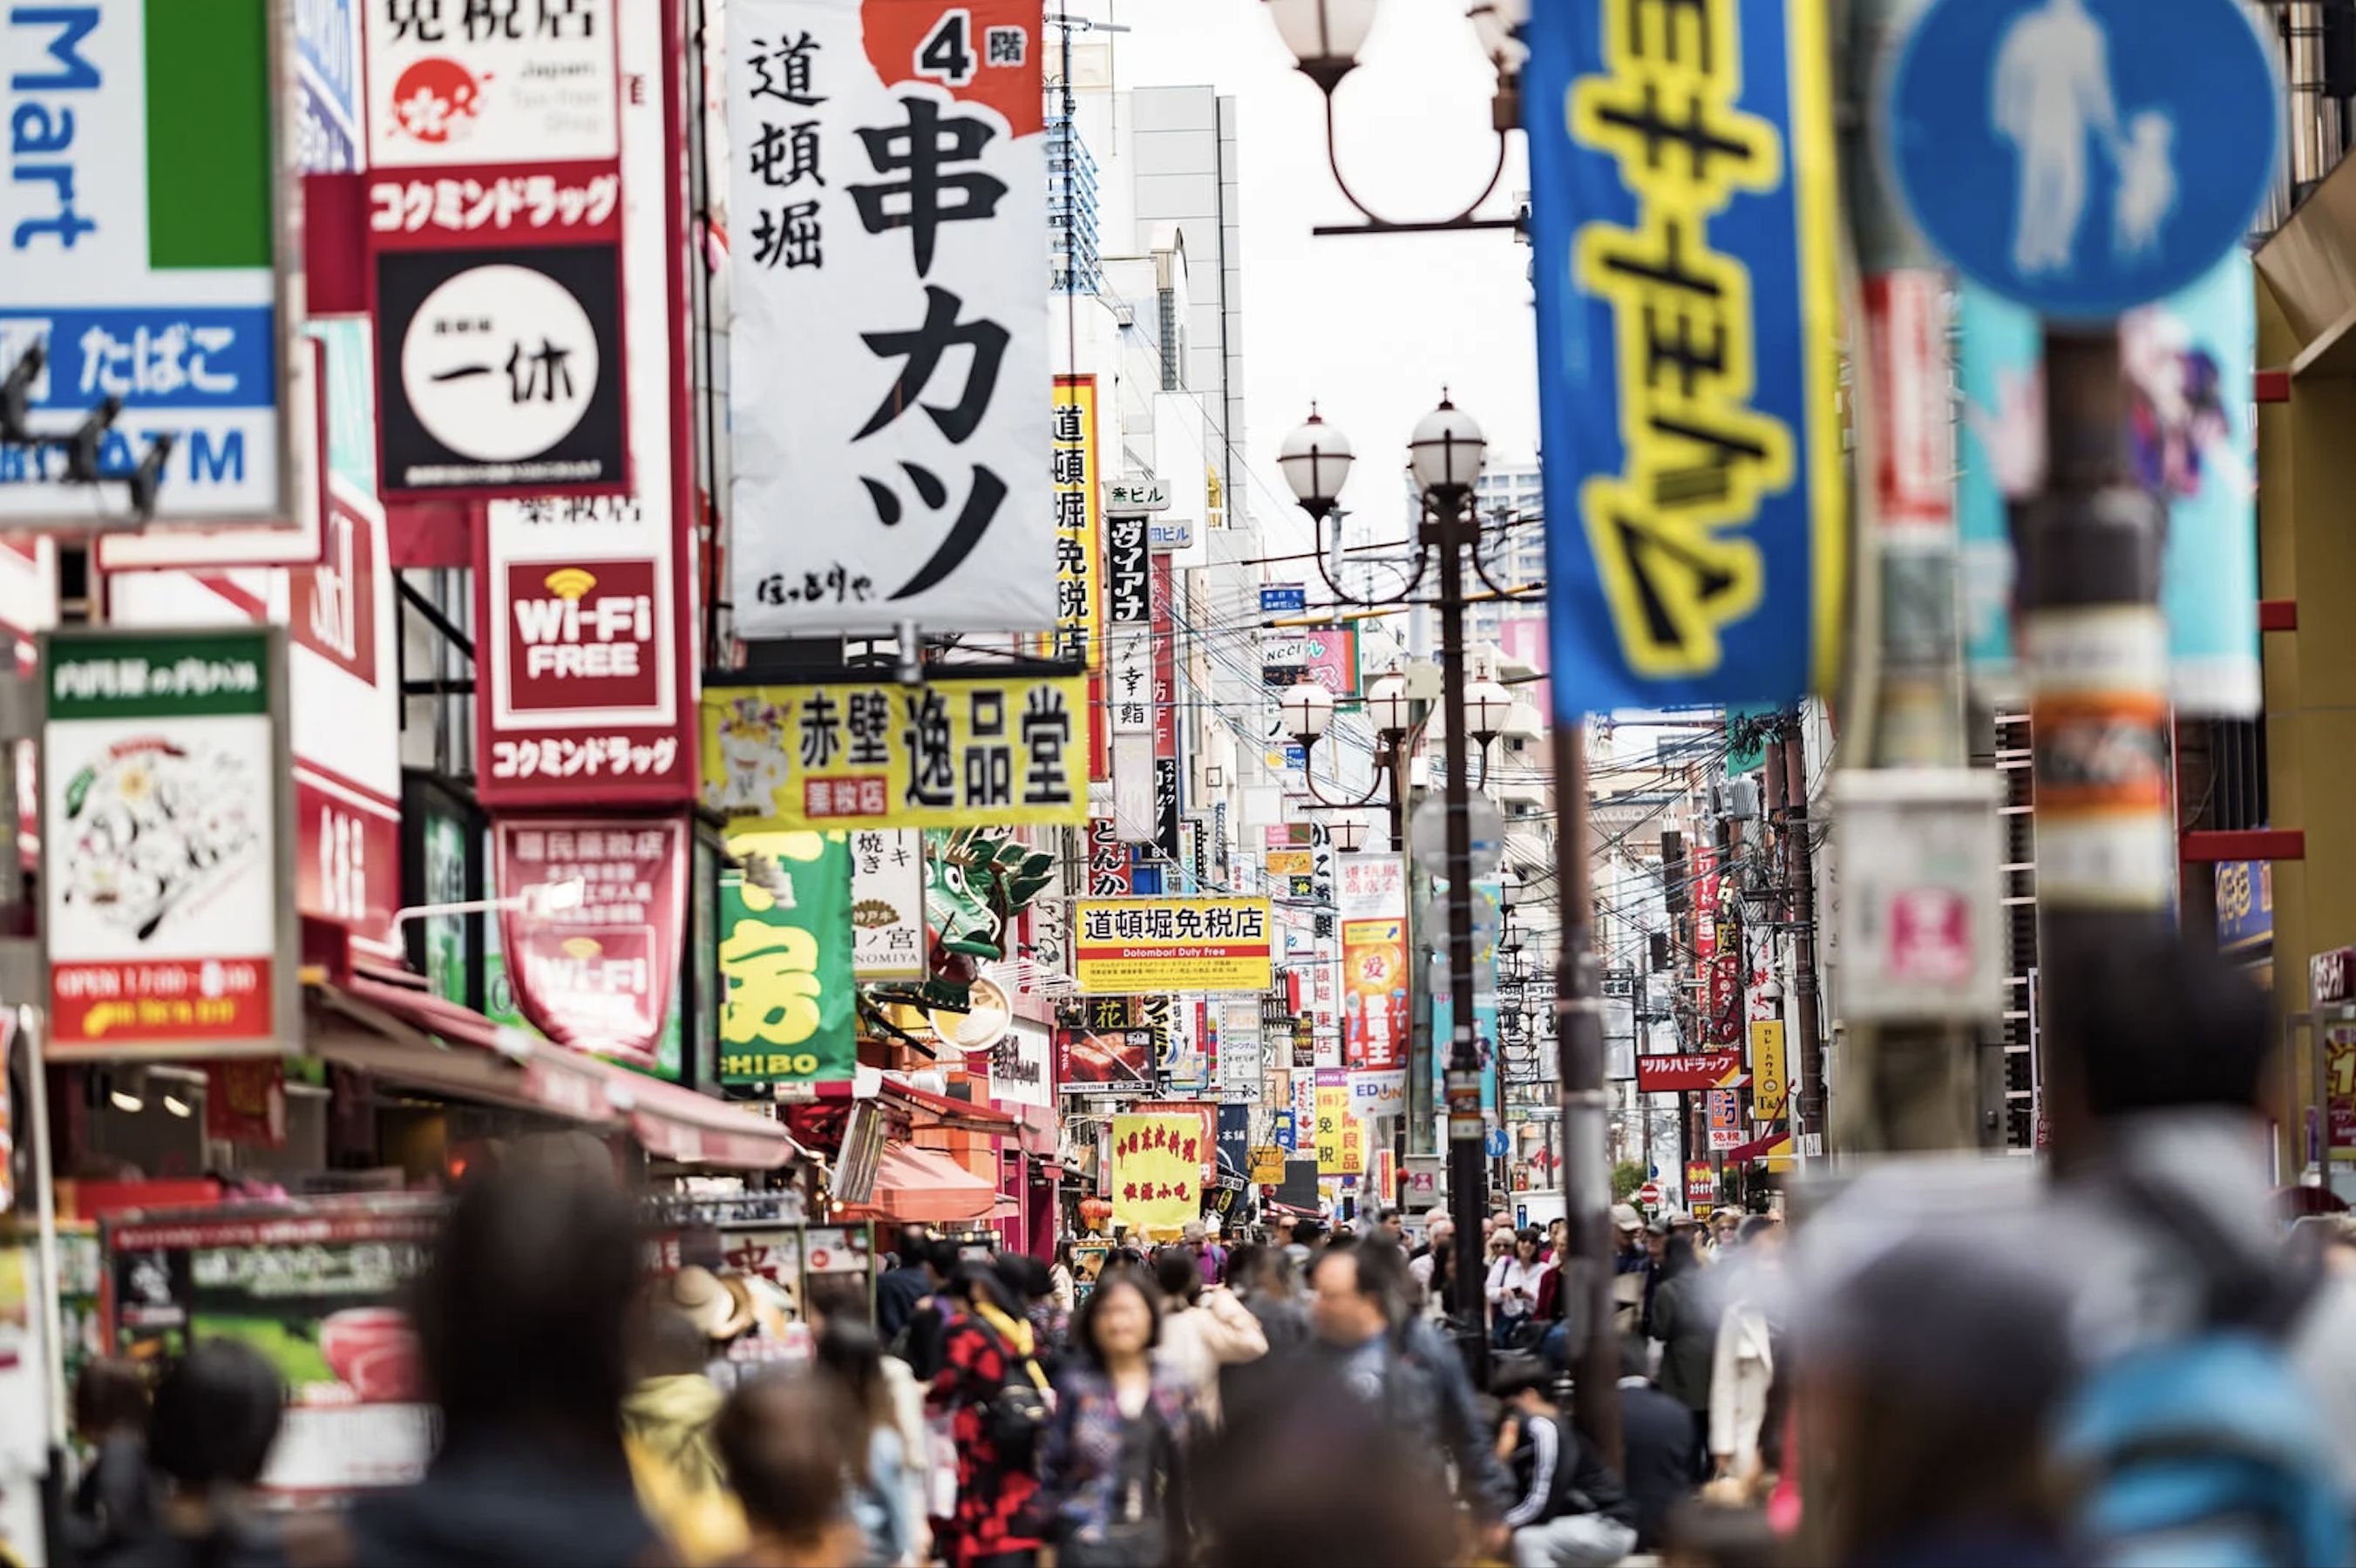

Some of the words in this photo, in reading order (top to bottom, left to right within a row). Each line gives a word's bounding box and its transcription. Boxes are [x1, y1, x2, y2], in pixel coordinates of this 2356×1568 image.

[10, 6, 102, 250] Mart
[749, 31, 828, 269] 道頓堀
[370, 175, 619, 231] コクミンドラッグ
[80, 324, 238, 393] たばこ
[845, 96, 1011, 603] 串カツ
[1111, 520, 1144, 621] ダイアナ
[514, 596, 652, 644] Wi-Fi
[526, 643, 640, 678] FREE
[492, 736, 678, 778] コクミンドラッグ
[1164, 760, 1175, 804] スナック
[1085, 907, 1263, 940] 道頓堀免税店
[1178, 947, 1201, 957] Duty
[1641, 1056, 1733, 1073] ツルハドラッグ
[1319, 1117, 1334, 1163] 免税
[1713, 1131, 1740, 1142] 免税
